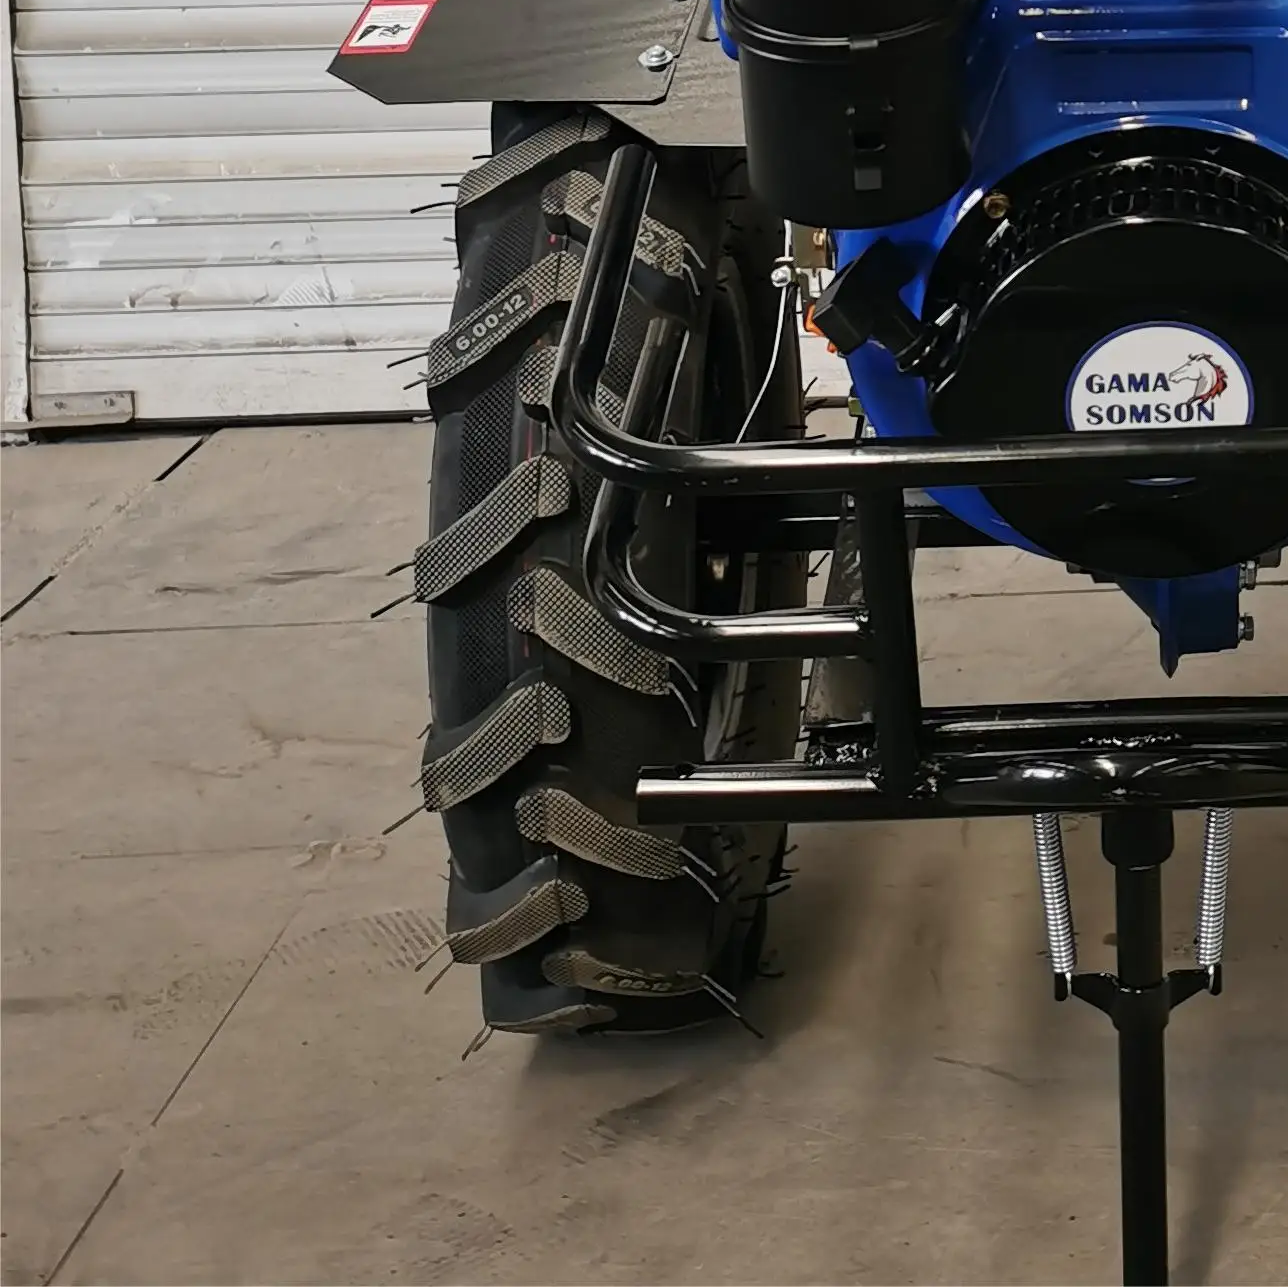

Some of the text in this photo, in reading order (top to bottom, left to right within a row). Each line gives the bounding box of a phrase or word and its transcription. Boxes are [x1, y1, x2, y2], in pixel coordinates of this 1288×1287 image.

[455, 293, 527, 351] 6.00-12
[1085, 372, 1170, 394] GAMA
[1086, 401, 1215, 426] SOMSON
